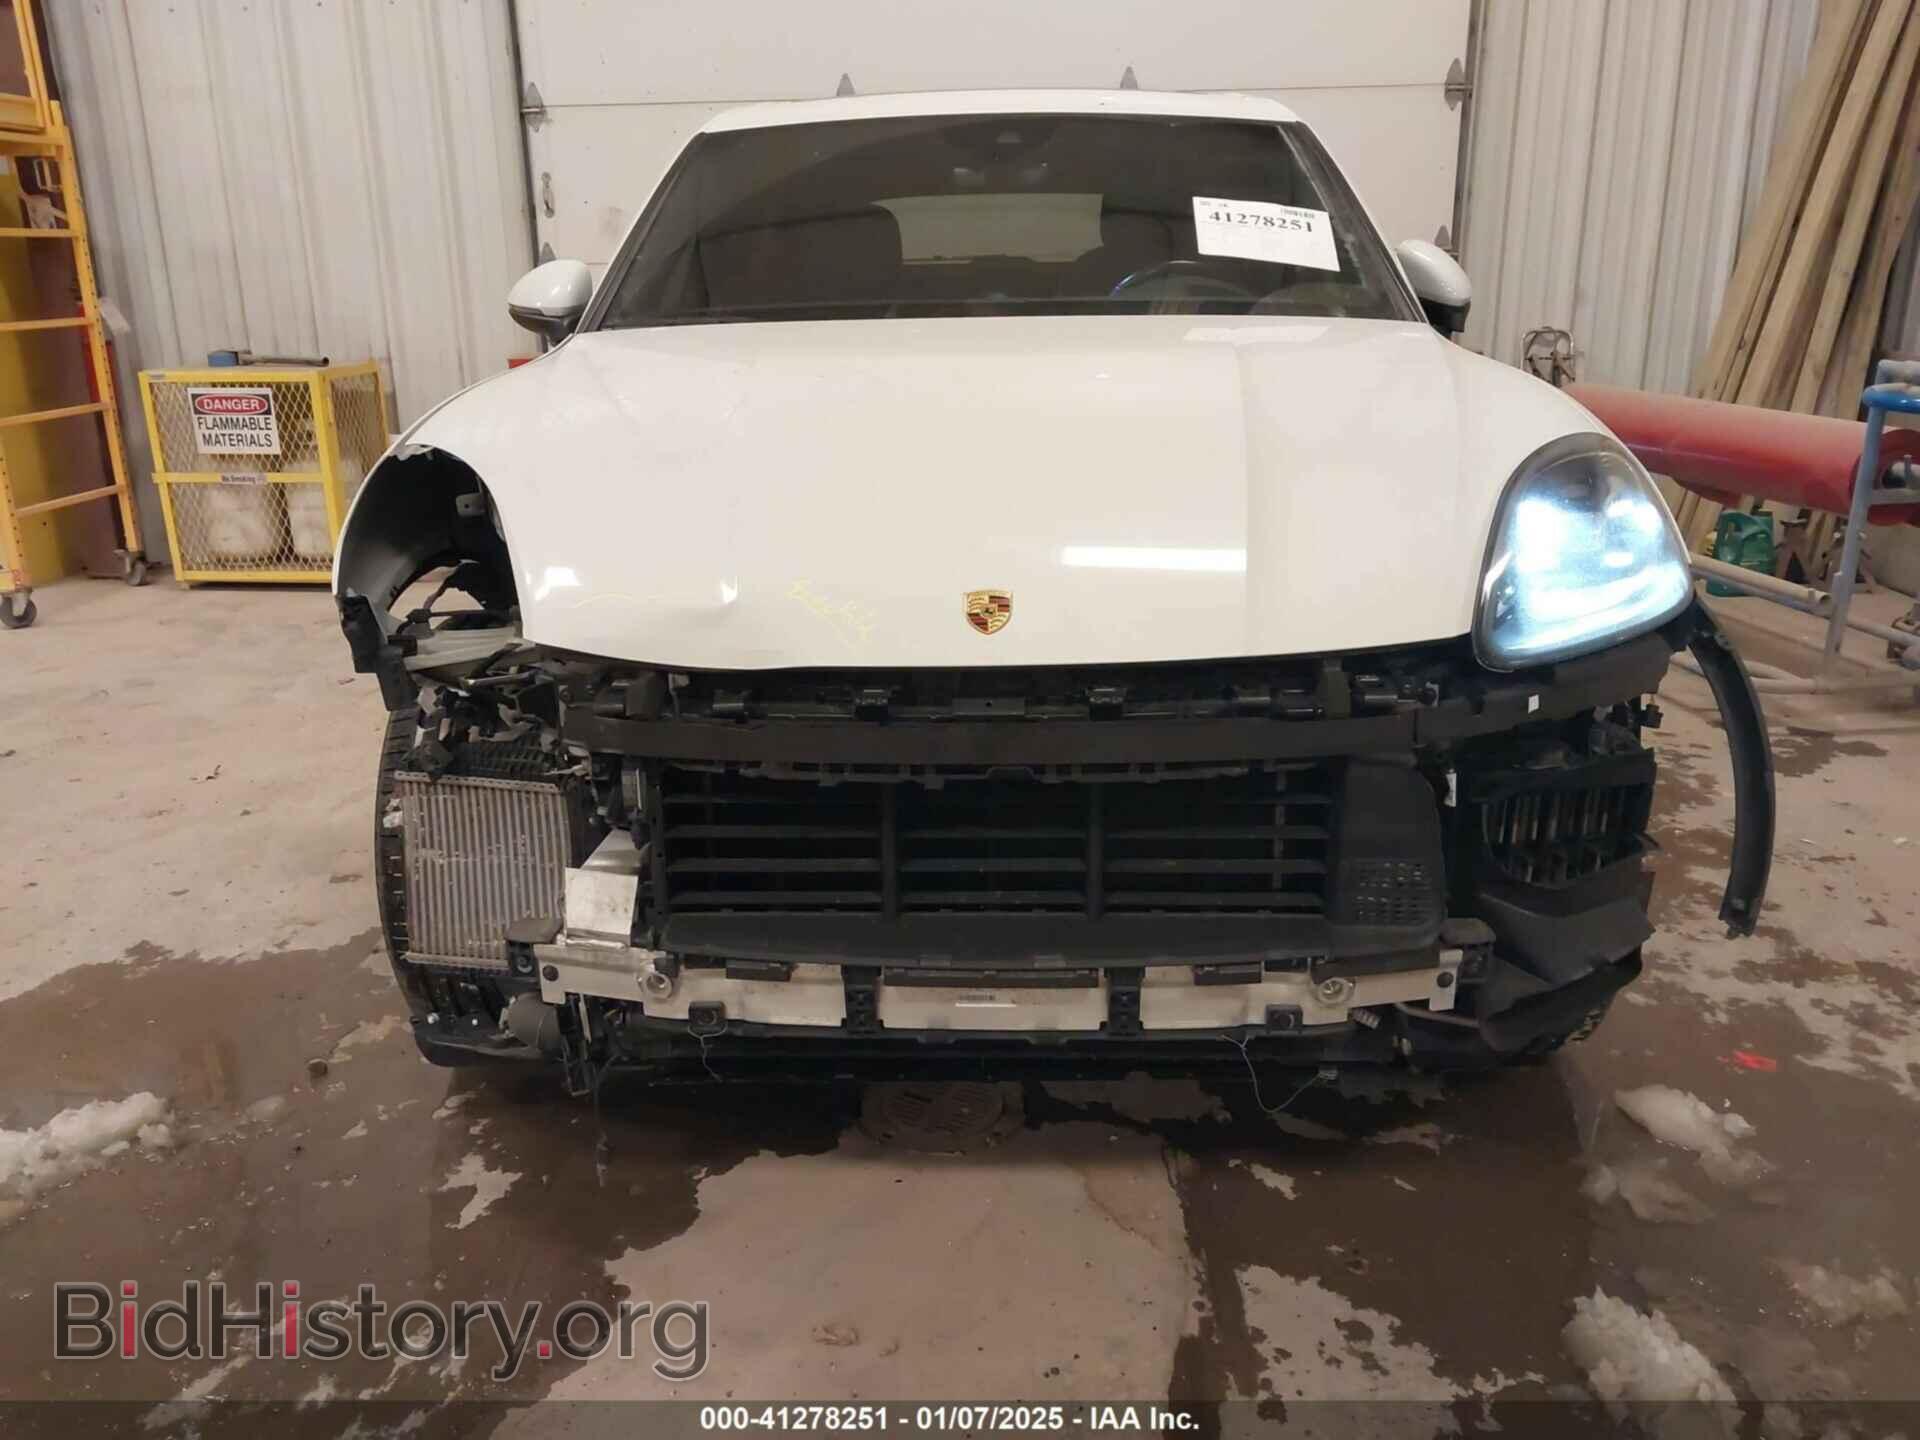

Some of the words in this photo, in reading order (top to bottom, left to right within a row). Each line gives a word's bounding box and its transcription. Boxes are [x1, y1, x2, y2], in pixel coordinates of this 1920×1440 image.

[1209, 211, 1312, 232] 41278251
[203, 399, 260, 410] DANGER
[197, 417, 272, 431] FLAMMABLE
[202, 434, 273, 447] MATERIALS
